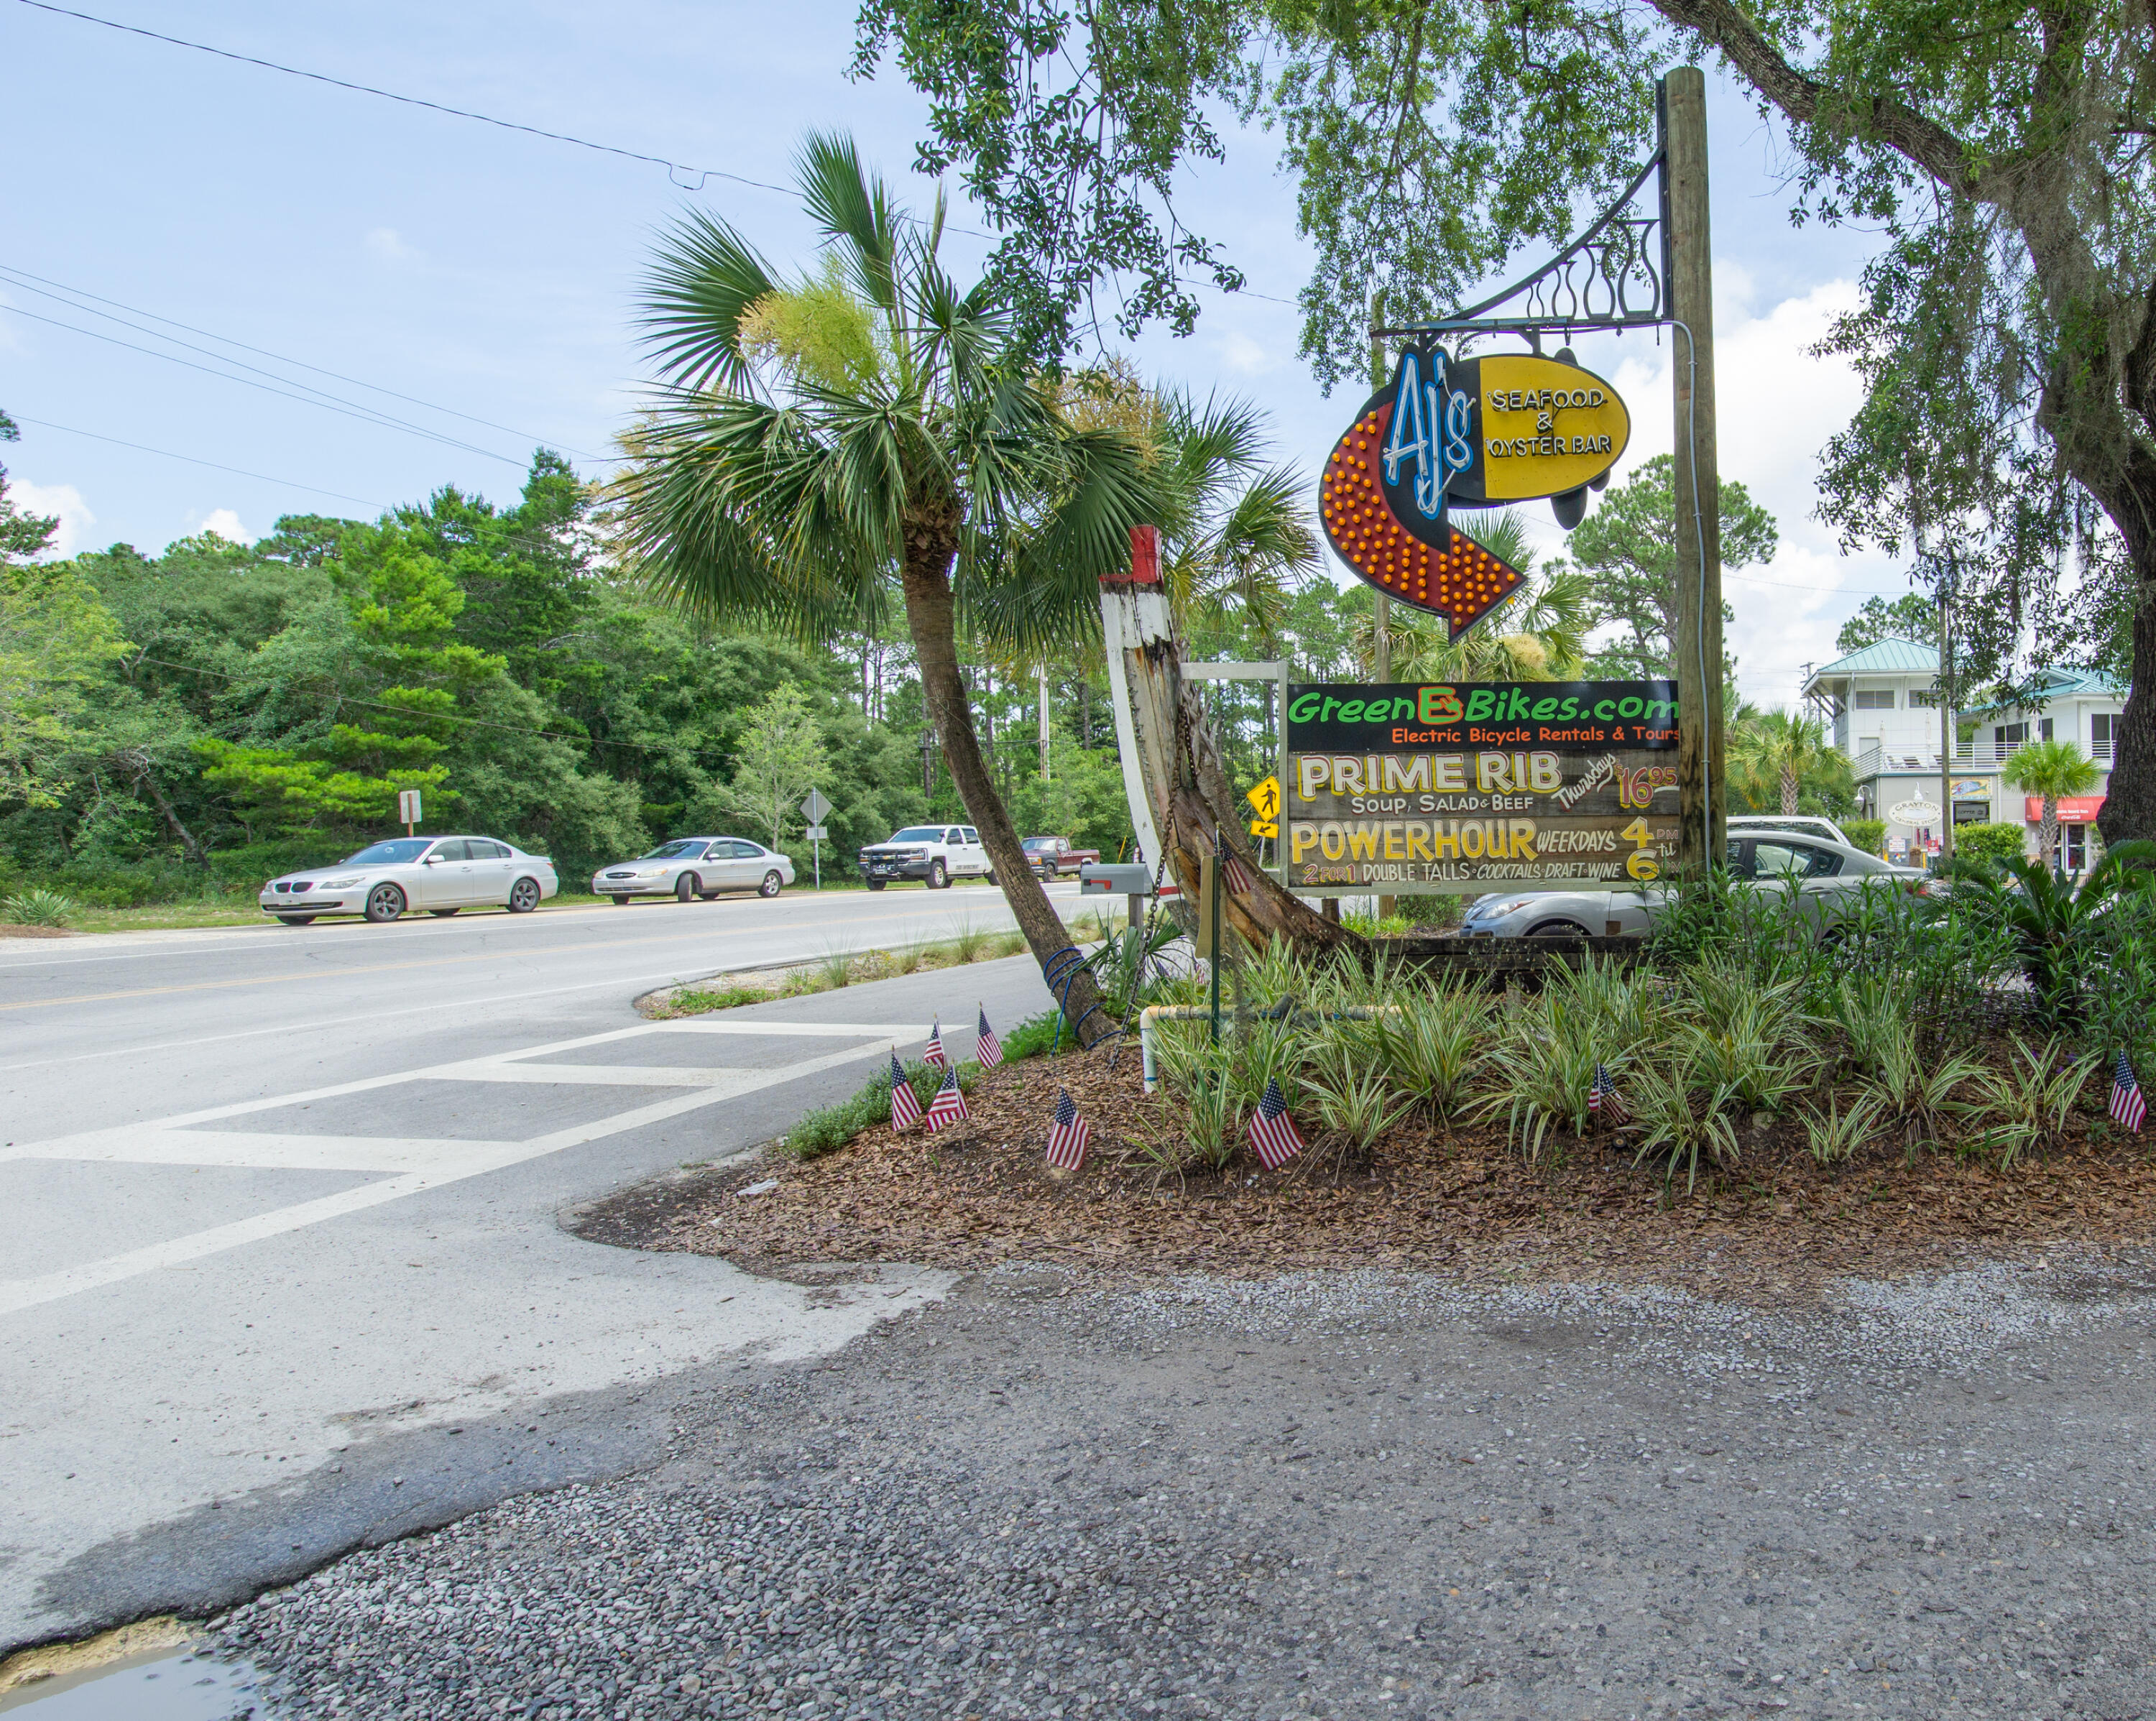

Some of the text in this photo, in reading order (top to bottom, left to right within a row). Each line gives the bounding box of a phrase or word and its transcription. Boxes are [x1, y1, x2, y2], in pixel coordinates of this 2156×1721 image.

[1492, 389, 1604, 408] SEAFOOD
[1537, 412, 1553, 431] &
[1489, 434, 1611, 458] OYSTER BAR
[1392, 726, 1679, 746] Electric Bicycle Rentals & Tours
[1296, 754, 1468, 801] PRIME
[1477, 751, 1562, 794] RIB
[1551, 753, 1616, 811] Thursdays
[1419, 795, 1478, 813] SALAD
[1480, 798, 1490, 808] &
[1491, 794, 1534, 811] BEEF
[1537, 829, 1616, 854] WEEKDAYS
[1620, 816, 1655, 849] 4
[1657, 829, 1679, 840] PM
[1656, 842, 1677, 857] til
[1302, 864, 1319, 884] 2
[1320, 867, 1347, 882] FOR
[1345, 864, 1356, 883] 1
[1362, 864, 1416, 882] DOUBLE
[1422, 862, 1470, 881] TALLS
[1477, 862, 1542, 880] COCKTAILS
[1544, 862, 1585, 879] DRAFT
[1588, 862, 1621, 878] WINE
[1626, 849, 1659, 881] 6
